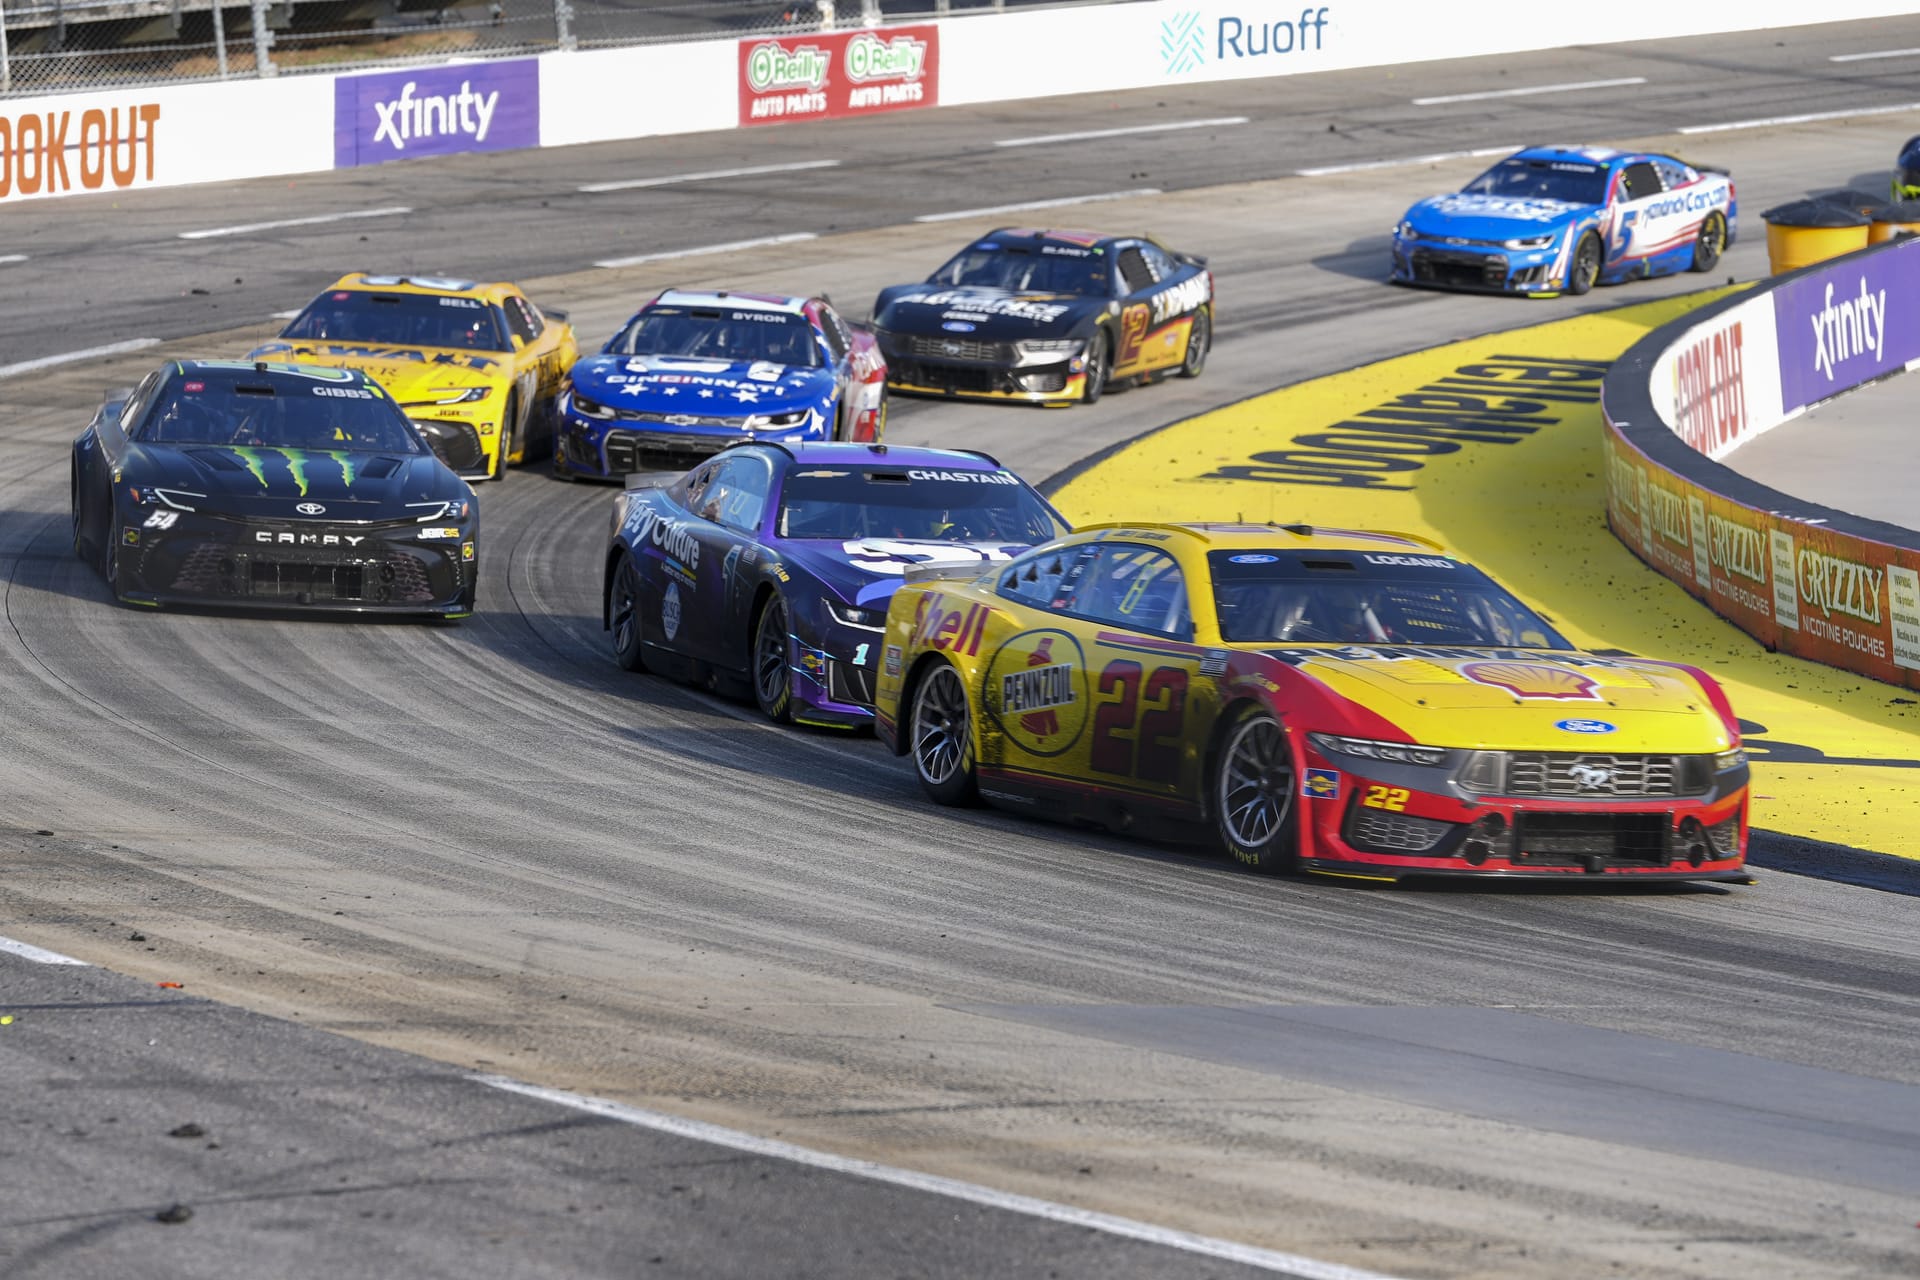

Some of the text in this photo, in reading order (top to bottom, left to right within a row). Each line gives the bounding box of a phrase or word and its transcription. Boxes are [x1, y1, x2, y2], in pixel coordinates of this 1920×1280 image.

[1217, 8, 1330, 60] Ruoff
[752, 48, 827, 86] O'Reilly
[850, 42, 923, 75] O'Reilly
[751, 92, 828, 118] AUTO PARTS
[849, 82, 924, 108] AUTO PARTS
[373, 80, 498, 149] xfinity
[79, 104, 160, 189] OUT
[1608, 209, 1639, 266] 5
[439, 297, 480, 309] BELL
[732, 311, 787, 324] BYRON
[1117, 303, 1150, 363] 12
[1811, 276, 1886, 381] xfinity
[312, 386, 373, 400] GIBBS
[605, 373, 785, 397] CINCINNATI
[1714, 320, 1747, 445] OUT
[907, 469, 1019, 485] CHASTAIN
[143, 509, 180, 530] 54
[255, 531, 365, 547] CAMRY
[1706, 513, 1767, 584] GRIZZLY
[1364, 553, 1455, 571] LOGANO
[1739, 587, 1770, 617] POUCHES
[1797, 548, 1884, 625] GRIZZLY
[909, 591, 990, 657] Shell
[1802, 614, 1886, 658] NICOTINE POUCHES
[852, 643, 870, 666] 1
[1002, 662, 1077, 715] PENNZOIL
[1089, 658, 1190, 787] 22
[1560, 719, 1611, 734] Ford
[1363, 785, 1410, 812] 22
